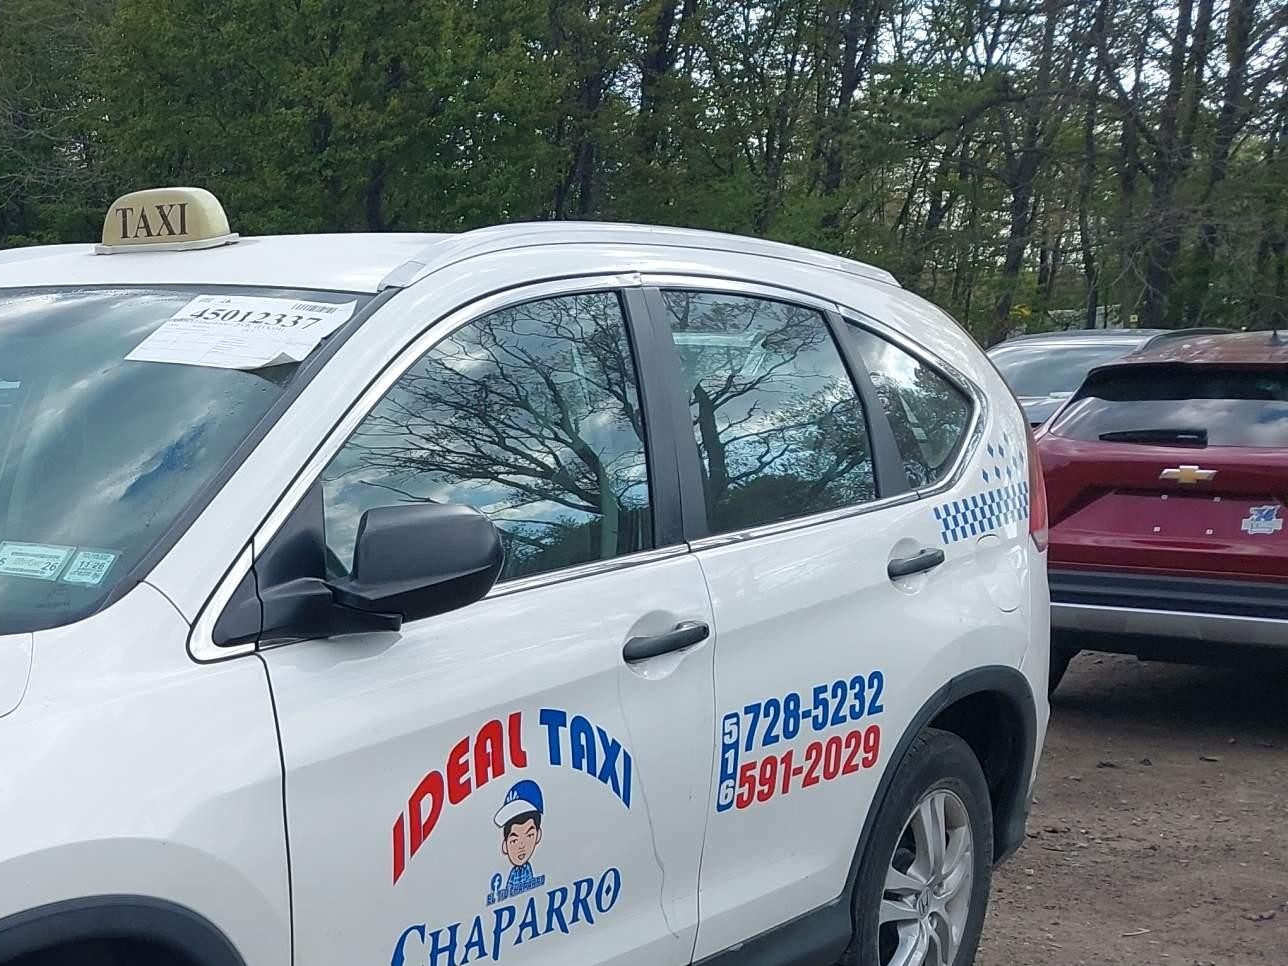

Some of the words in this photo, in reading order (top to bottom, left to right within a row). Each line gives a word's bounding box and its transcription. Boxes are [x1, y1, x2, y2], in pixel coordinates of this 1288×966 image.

[116, 202, 189, 239] TAXI
[190, 307, 323, 330] 45012337
[41, 561, 58, 572] 26
[742, 669, 885, 753] 728-5232
[392, 711, 528, 885] IDEAL
[539, 707, 633, 811] TAXI
[736, 724, 881, 810] 591-2029
